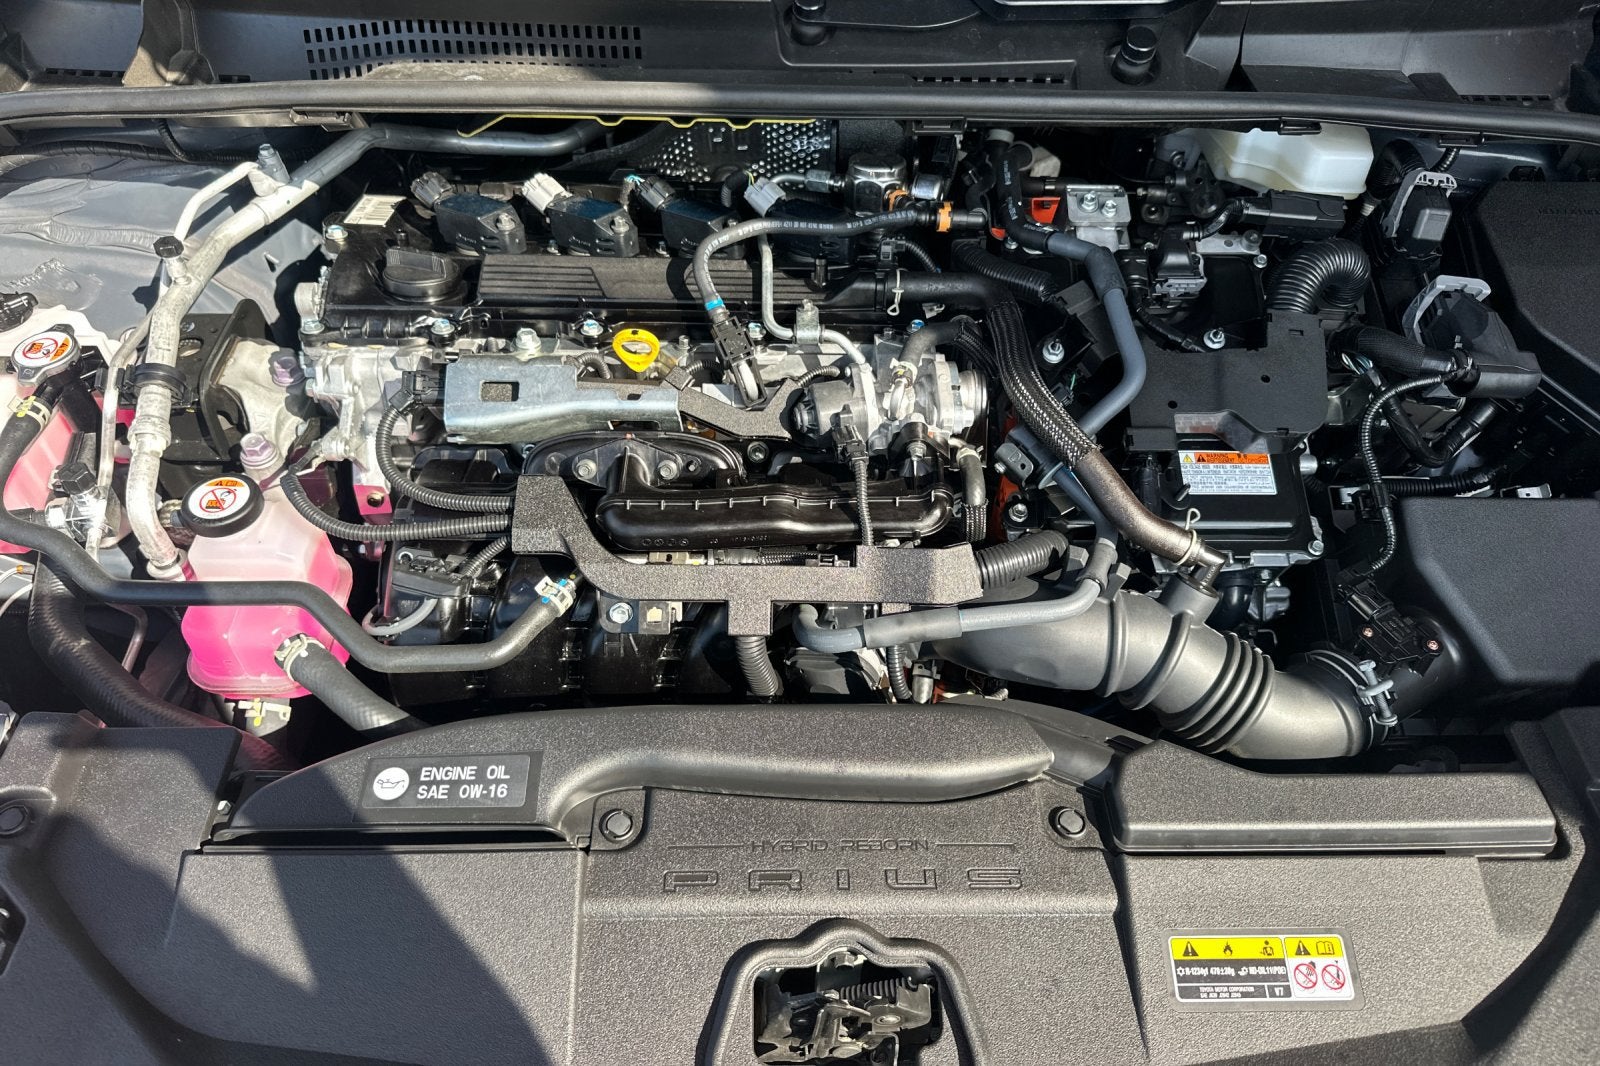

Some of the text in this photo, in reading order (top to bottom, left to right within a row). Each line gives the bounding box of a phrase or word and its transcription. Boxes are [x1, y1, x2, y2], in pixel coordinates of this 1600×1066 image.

[420, 764, 511, 781] ENGINE OIL
[416, 783, 509, 800] SAE 0W-16
[751, 838, 929, 853] HYBRID REBORN
[662, 867, 1023, 892] PRIUS
[1274, 987, 1284, 997] V7
